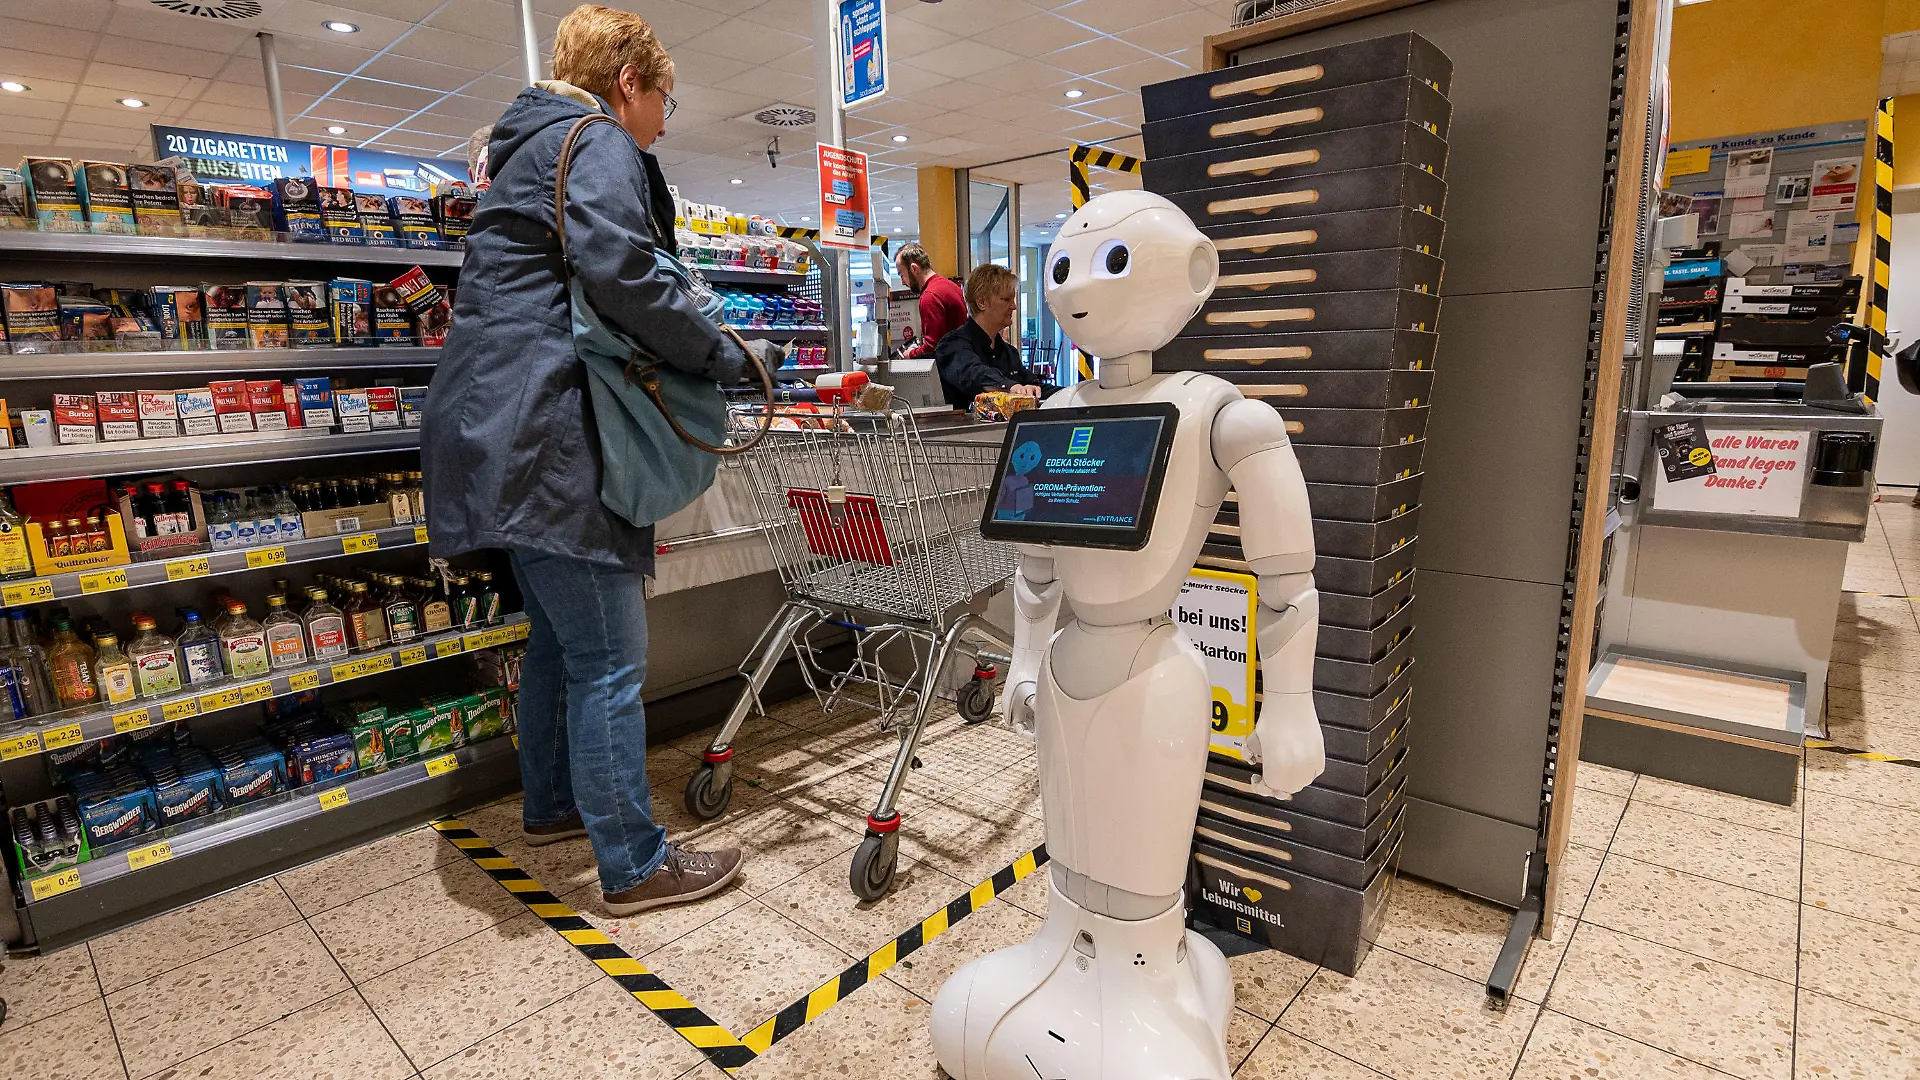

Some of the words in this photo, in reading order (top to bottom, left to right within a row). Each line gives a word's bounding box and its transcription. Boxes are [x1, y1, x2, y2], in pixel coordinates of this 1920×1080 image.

[1722, 138, 1758, 149] Kunde
[1778, 132, 1816, 142] Kunde
[166, 134, 188, 153] 20
[190, 136, 289, 163] ZIGARETTEN
[823, 150, 862, 165] JUGENDSCHUTZ
[197, 159, 283, 182] AUSZEITEN
[368, 392, 396, 400] Silverado
[140, 402, 175, 414] Chesterfield
[180, 400, 212, 414] Chesterfield
[340, 400, 367, 414] Chesterfield
[1712, 436, 1742, 450] alle
[1745, 436, 1800, 450] Waren
[1046, 458, 1072, 467] EDEKA
[1073, 458, 1106, 467] Stöcker
[1749, 457, 1796, 474] legen
[1034, 484, 1106, 492] CORONA-Prävention:
[1704, 475, 1756, 490] Danke
[362, 538, 378, 546] 0,99
[268, 551, 285, 560] 0,99
[190, 562, 209, 572] 2,49
[106, 575, 126, 585] 1,00
[30, 586, 52, 597] 2,99
[1215, 585, 1248, 595] Stöcker
[1178, 606, 1203, 626] bei
[1209, 615, 1247, 634] uns!
[446, 642, 460, 652] 1,99
[412, 650, 425, 660] 2,29
[378, 657, 392, 666] 2,69
[350, 663, 367, 674] 2,19
[302, 674, 318, 685] 1,99
[255, 684, 272, 696] 1,99
[222, 692, 240, 703] 2,39
[177, 702, 196, 713] 2,19
[467, 698, 501, 721] Underberg
[130, 713, 148, 724] 1,39
[416, 712, 452, 736] Underberg
[60, 728, 81, 740] 2,29
[17, 738, 39, 750] 3,99
[442, 757, 457, 768] 3,49
[230, 770, 273, 798] BERGWUNDER
[163, 788, 210, 818] BERGWUNDER
[332, 792, 347, 802] 0,99
[92, 805, 142, 838] BERGWUNDER
[152, 846, 171, 858] 0,99
[58, 874, 79, 886] 0,49
[1218, 878, 1240, 898] Wir
[1202, 888, 1285, 928] Lebensmittel.
